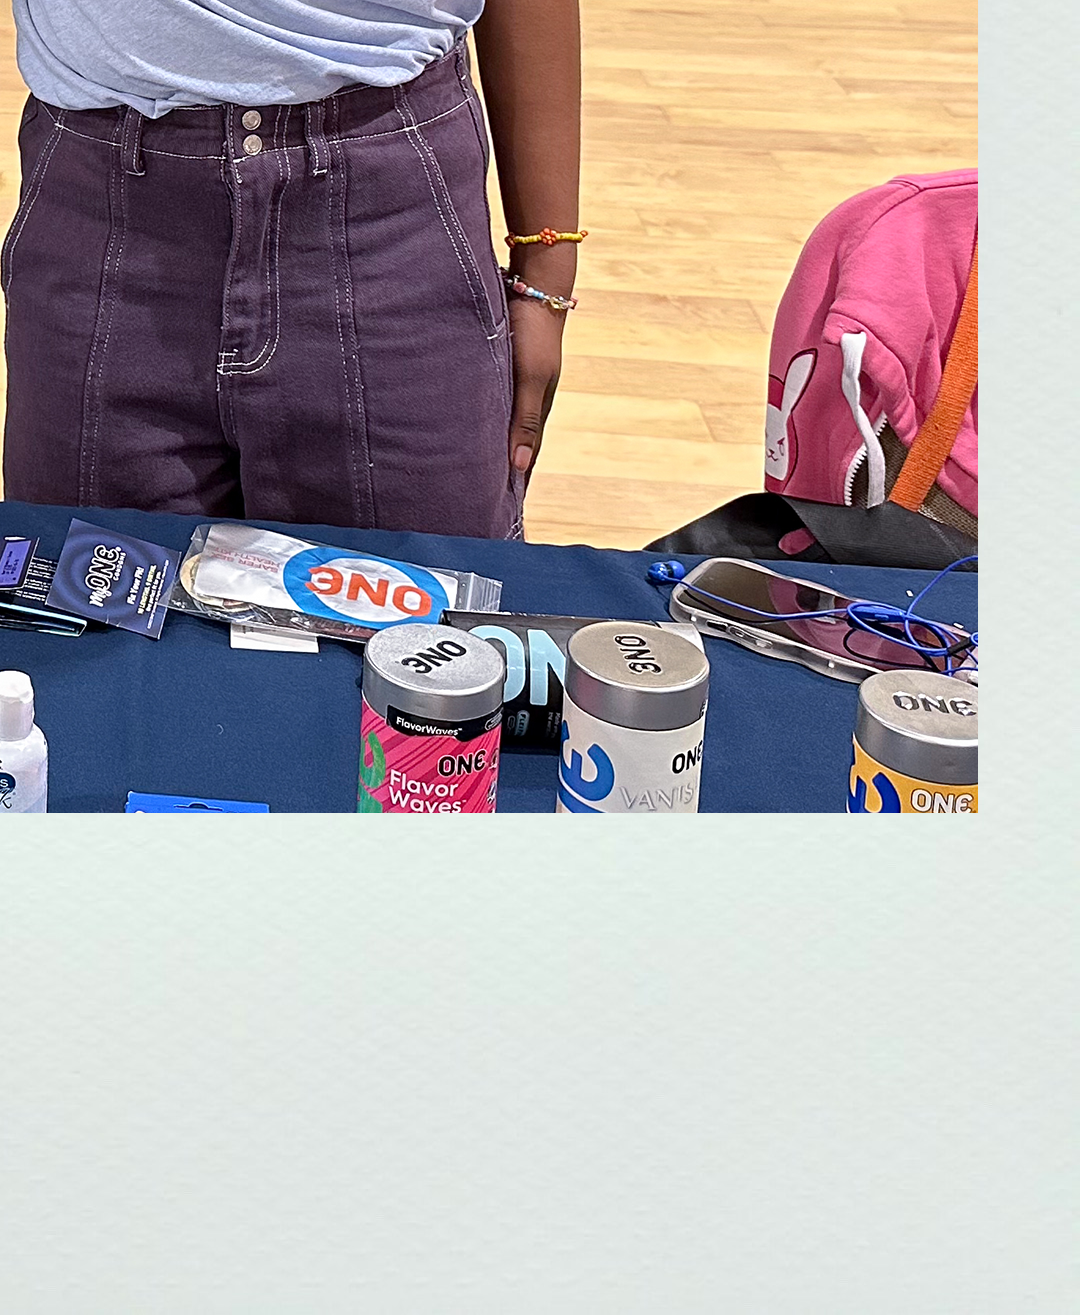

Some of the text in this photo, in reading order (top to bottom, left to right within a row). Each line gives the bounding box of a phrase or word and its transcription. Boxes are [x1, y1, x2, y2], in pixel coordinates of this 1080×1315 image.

[112, 552, 126, 581] CONDOMS
[237, 558, 279, 574] SAFER
[305, 566, 432, 617] ONE
[400, 639, 467, 674] ONE
[615, 635, 662, 675] ONE
[892, 691, 977, 716] ONE
[438, 749, 487, 777] ONE
[390, 769, 459, 797] Flavor
